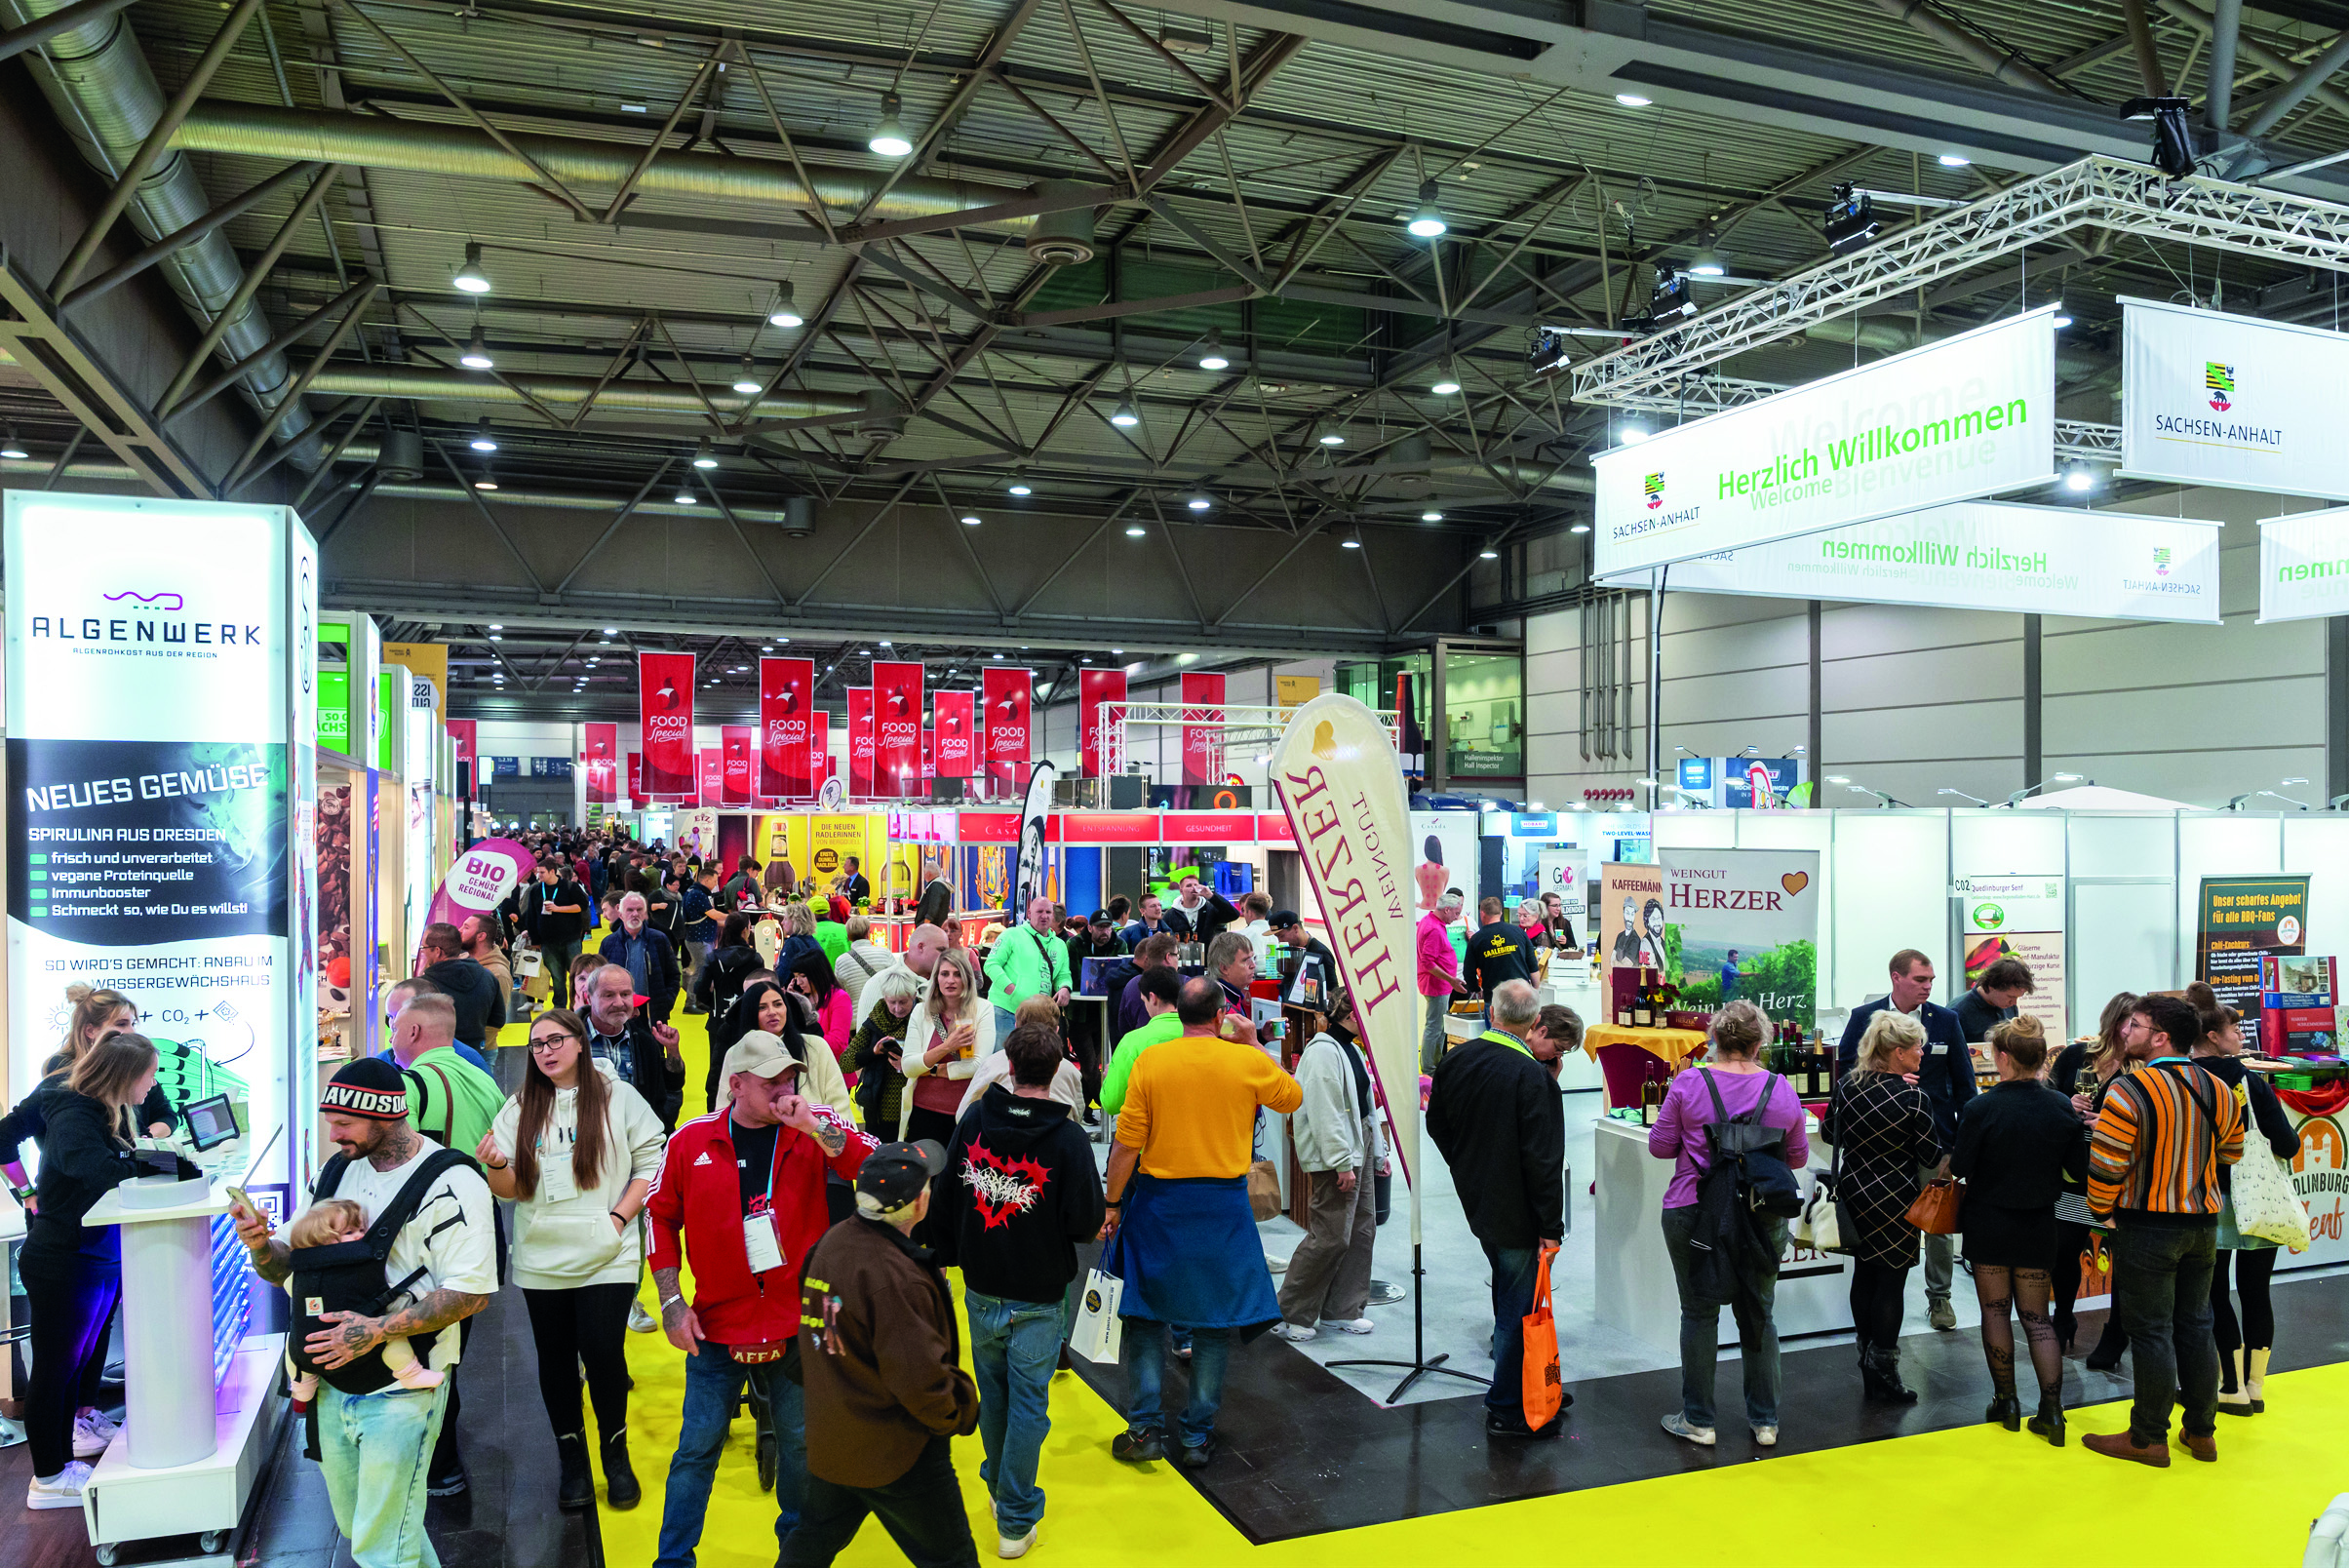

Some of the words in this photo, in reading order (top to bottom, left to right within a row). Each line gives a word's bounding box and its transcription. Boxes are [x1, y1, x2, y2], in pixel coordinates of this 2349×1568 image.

[2156, 414, 2282, 446] SACHSEN-ANHALT
[1718, 451, 1819, 500] Herzlich
[1828, 397, 2027, 470] Willkommen
[1750, 478, 1832, 511] Welcome
[1613, 505, 1700, 540] SACHSEN-ANHALT
[32, 616, 260, 646] ALGENWERK
[73, 647, 143, 657] ALGENROHKOST
[649, 716, 687, 727] FOOD
[769, 720, 806, 731] FOOD
[881, 722, 917, 733] FOOD
[646, 726, 687, 743] Special
[765, 731, 805, 746] Special
[992, 726, 1025, 737] FOOD
[878, 732, 917, 748] Special
[941, 738, 968, 748] FOOD
[989, 736, 1025, 752] Special
[939, 746, 968, 760] Special
[26, 777, 134, 811] NEUES
[138, 763, 269, 800] GEMÜSE
[28, 828, 113, 842] SPIRULINA
[116, 828, 150, 842] AUS
[153, 828, 226, 842] DRESDEN
[985, 826, 1018, 835] CASA
[1082, 824, 1140, 833] ENTSPANNUNG
[1186, 824, 1232, 833] GESUNDHEIT
[52, 851, 92, 865] frisch
[94, 852, 120, 864] und
[122, 851, 213, 865] unverarbeitet
[52, 871, 101, 883] vegane
[103, 870, 194, 882] Proteinquelle
[465, 856, 506, 882] BIO
[1670, 869, 1727, 879] WEINGUT
[458, 883, 495, 902] REGIONAL
[468, 877, 500, 893] GEMÜSE
[52, 887, 151, 899] Immunbooster
[1669, 883, 1783, 911] HERZER
[2212, 895, 2234, 907] Unser
[2236, 894, 2269, 907] scharfes
[2271, 893, 2301, 909] Angebot
[52, 904, 119, 916] Schmeckt
[124, 906, 143, 917] so,
[146, 904, 169, 915] wie
[171, 904, 189, 915] Du
[191, 905, 208, 915] es
[209, 902, 249, 915] willst!
[2212, 911, 2224, 923] für
[2225, 912, 2239, 922] alle
[2241, 911, 2276, 923] BBQ-Fans
[2212, 941, 2250, 951] Chili-Kochkurs
[45, 960, 65, 971] SO
[70, 959, 123, 970] WIRD'S
[126, 958, 201, 969] GEMACHT:
[204, 956, 254, 967] ANBAU
[256, 956, 273, 966] IM
[1639, 951, 1650, 965] DIE
[93, 974, 271, 990] WASSERGEWÄCHSHAUS
[1759, 991, 1807, 1010] Herz
[2292, 1172, 2349, 1196] DLINBURG
[733, 1350, 781, 1363] AFFA
